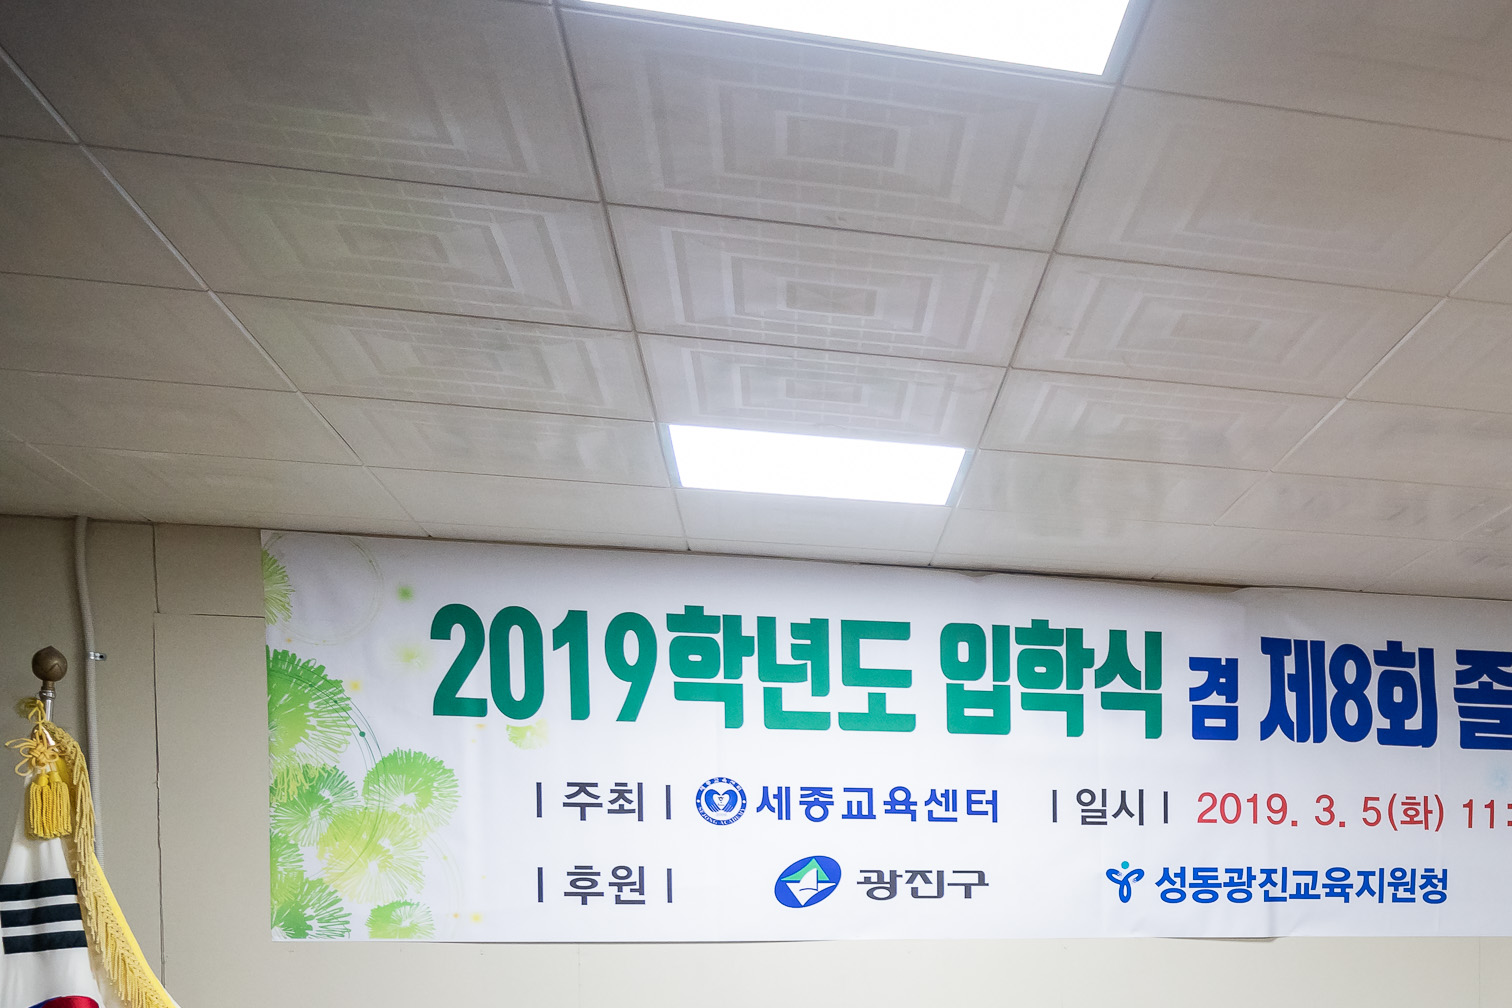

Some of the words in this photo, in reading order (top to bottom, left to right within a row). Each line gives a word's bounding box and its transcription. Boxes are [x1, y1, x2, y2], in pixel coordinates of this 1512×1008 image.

[430, 603, 917, 732] 2019학년도
[940, 618, 1163, 740] 입학식
[1188, 656, 1239, 742] 겸
[1260, 636, 1440, 749] 제8회
[562, 781, 645, 823] 주최
[756, 784, 1001, 824] 세종교육센터
[1076, 788, 1146, 826] 일시
[1197, 792, 1299, 828] 2019.
[1314, 794, 1346, 829] 3.
[1361, 794, 1444, 833] 5(화)
[563, 864, 647, 906] 후원
[856, 869, 990, 901] 광진구
[1154, 866, 1449, 905] 성동광진교육지원청
